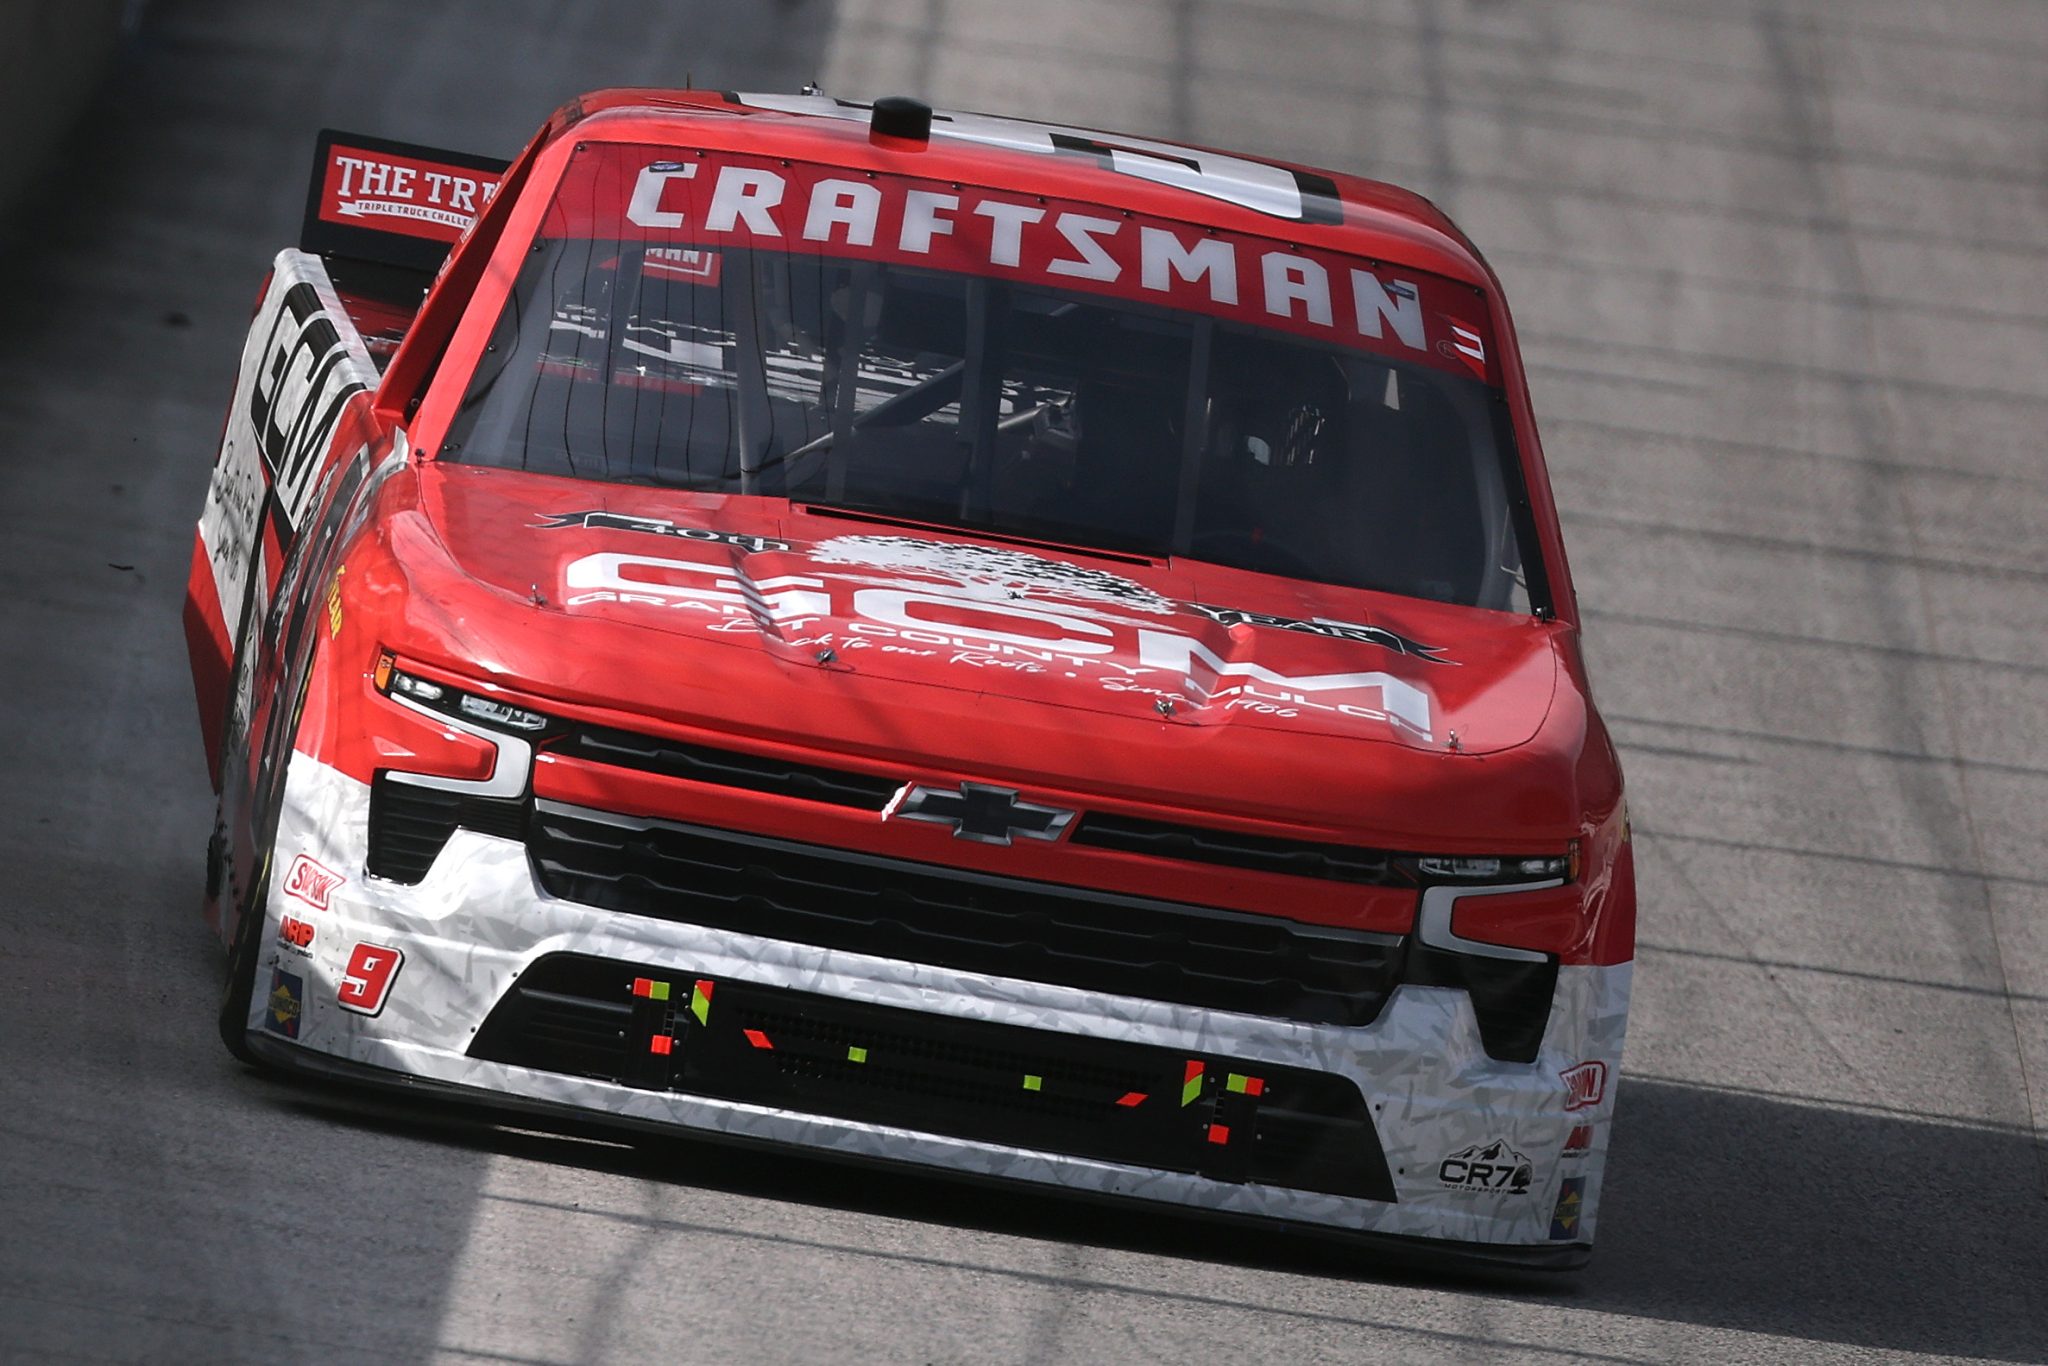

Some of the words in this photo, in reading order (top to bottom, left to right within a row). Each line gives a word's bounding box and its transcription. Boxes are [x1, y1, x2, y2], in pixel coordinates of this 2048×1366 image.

[336, 156, 416, 199] THE
[358, 202, 393, 213] TRIPLE
[397, 207, 428, 217] TRUCK
[626, 160, 1428, 352] CRAFTSMAN
[567, 591, 821, 631] GRANT
[849, 623, 1157, 675] COUNTY
[567, 552, 1431, 732] GCM
[840, 635, 873, 649] to
[337, 941, 404, 1016] 9
[1440, 1159, 1516, 1187] CR7
